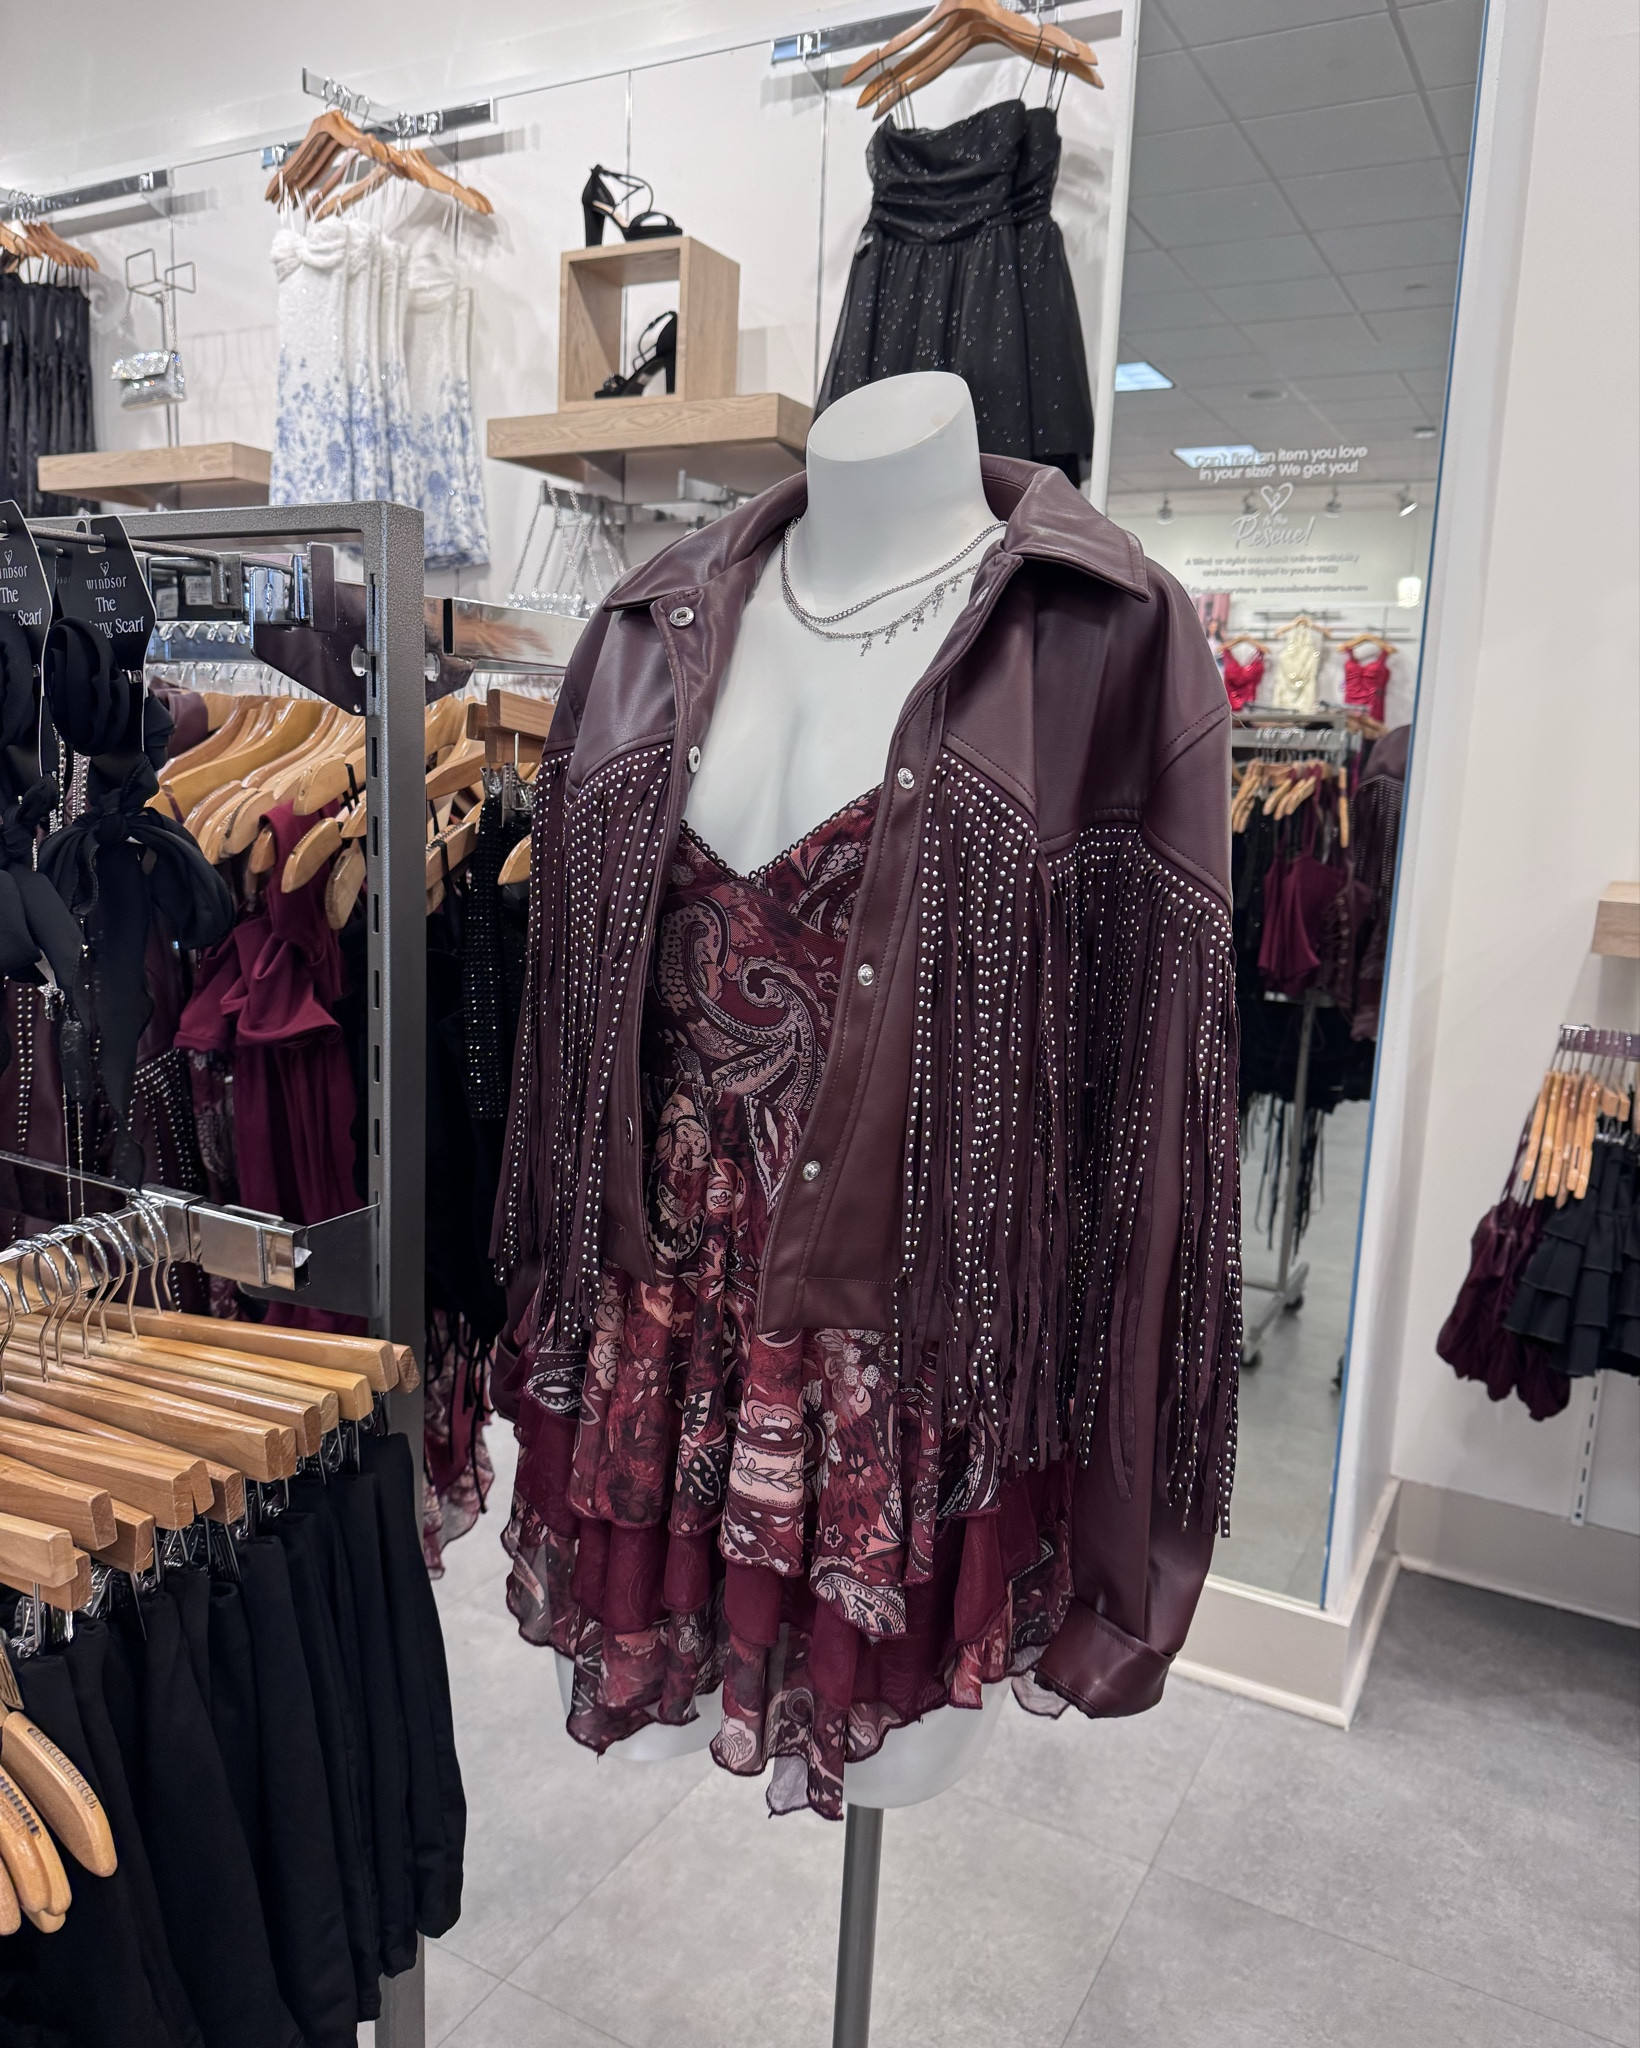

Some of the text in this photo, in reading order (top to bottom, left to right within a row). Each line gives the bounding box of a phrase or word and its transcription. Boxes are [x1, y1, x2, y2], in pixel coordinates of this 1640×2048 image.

[1259, 451, 1276, 464] an
[1277, 447, 1309, 462] item
[1311, 447, 1337, 464] you
[1338, 445, 1368, 459] love
[1199, 459, 1359, 483] in your size? We got you!
[1231, 511, 1316, 550] Rescue!
[0, 587, 19, 604] The
[95, 596, 117, 613] The
[17, 607, 42, 627] Scarf
[115, 615, 144, 634] Scarf
